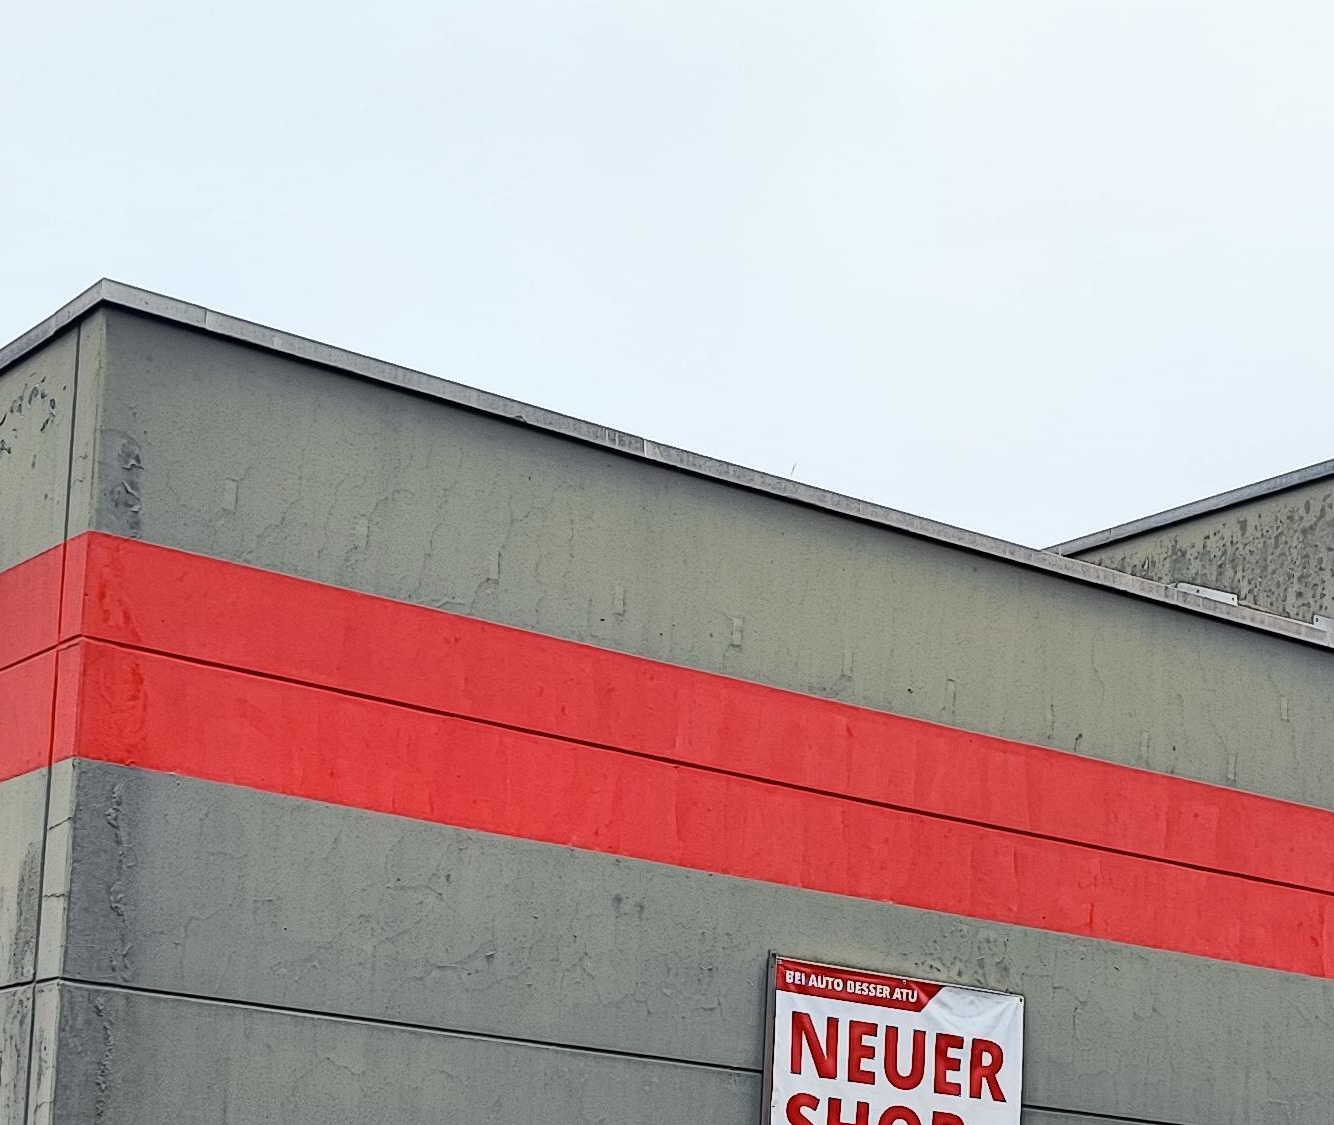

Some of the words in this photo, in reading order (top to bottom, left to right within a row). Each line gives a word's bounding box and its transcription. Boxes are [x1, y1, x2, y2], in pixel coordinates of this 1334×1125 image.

[785, 970, 806, 986] BEI
[808, 973, 844, 992] AUTO
[846, 980, 891, 999] BESSER
[892, 987, 918, 1003] ATU
[790, 1010, 1008, 1103] NEUER
